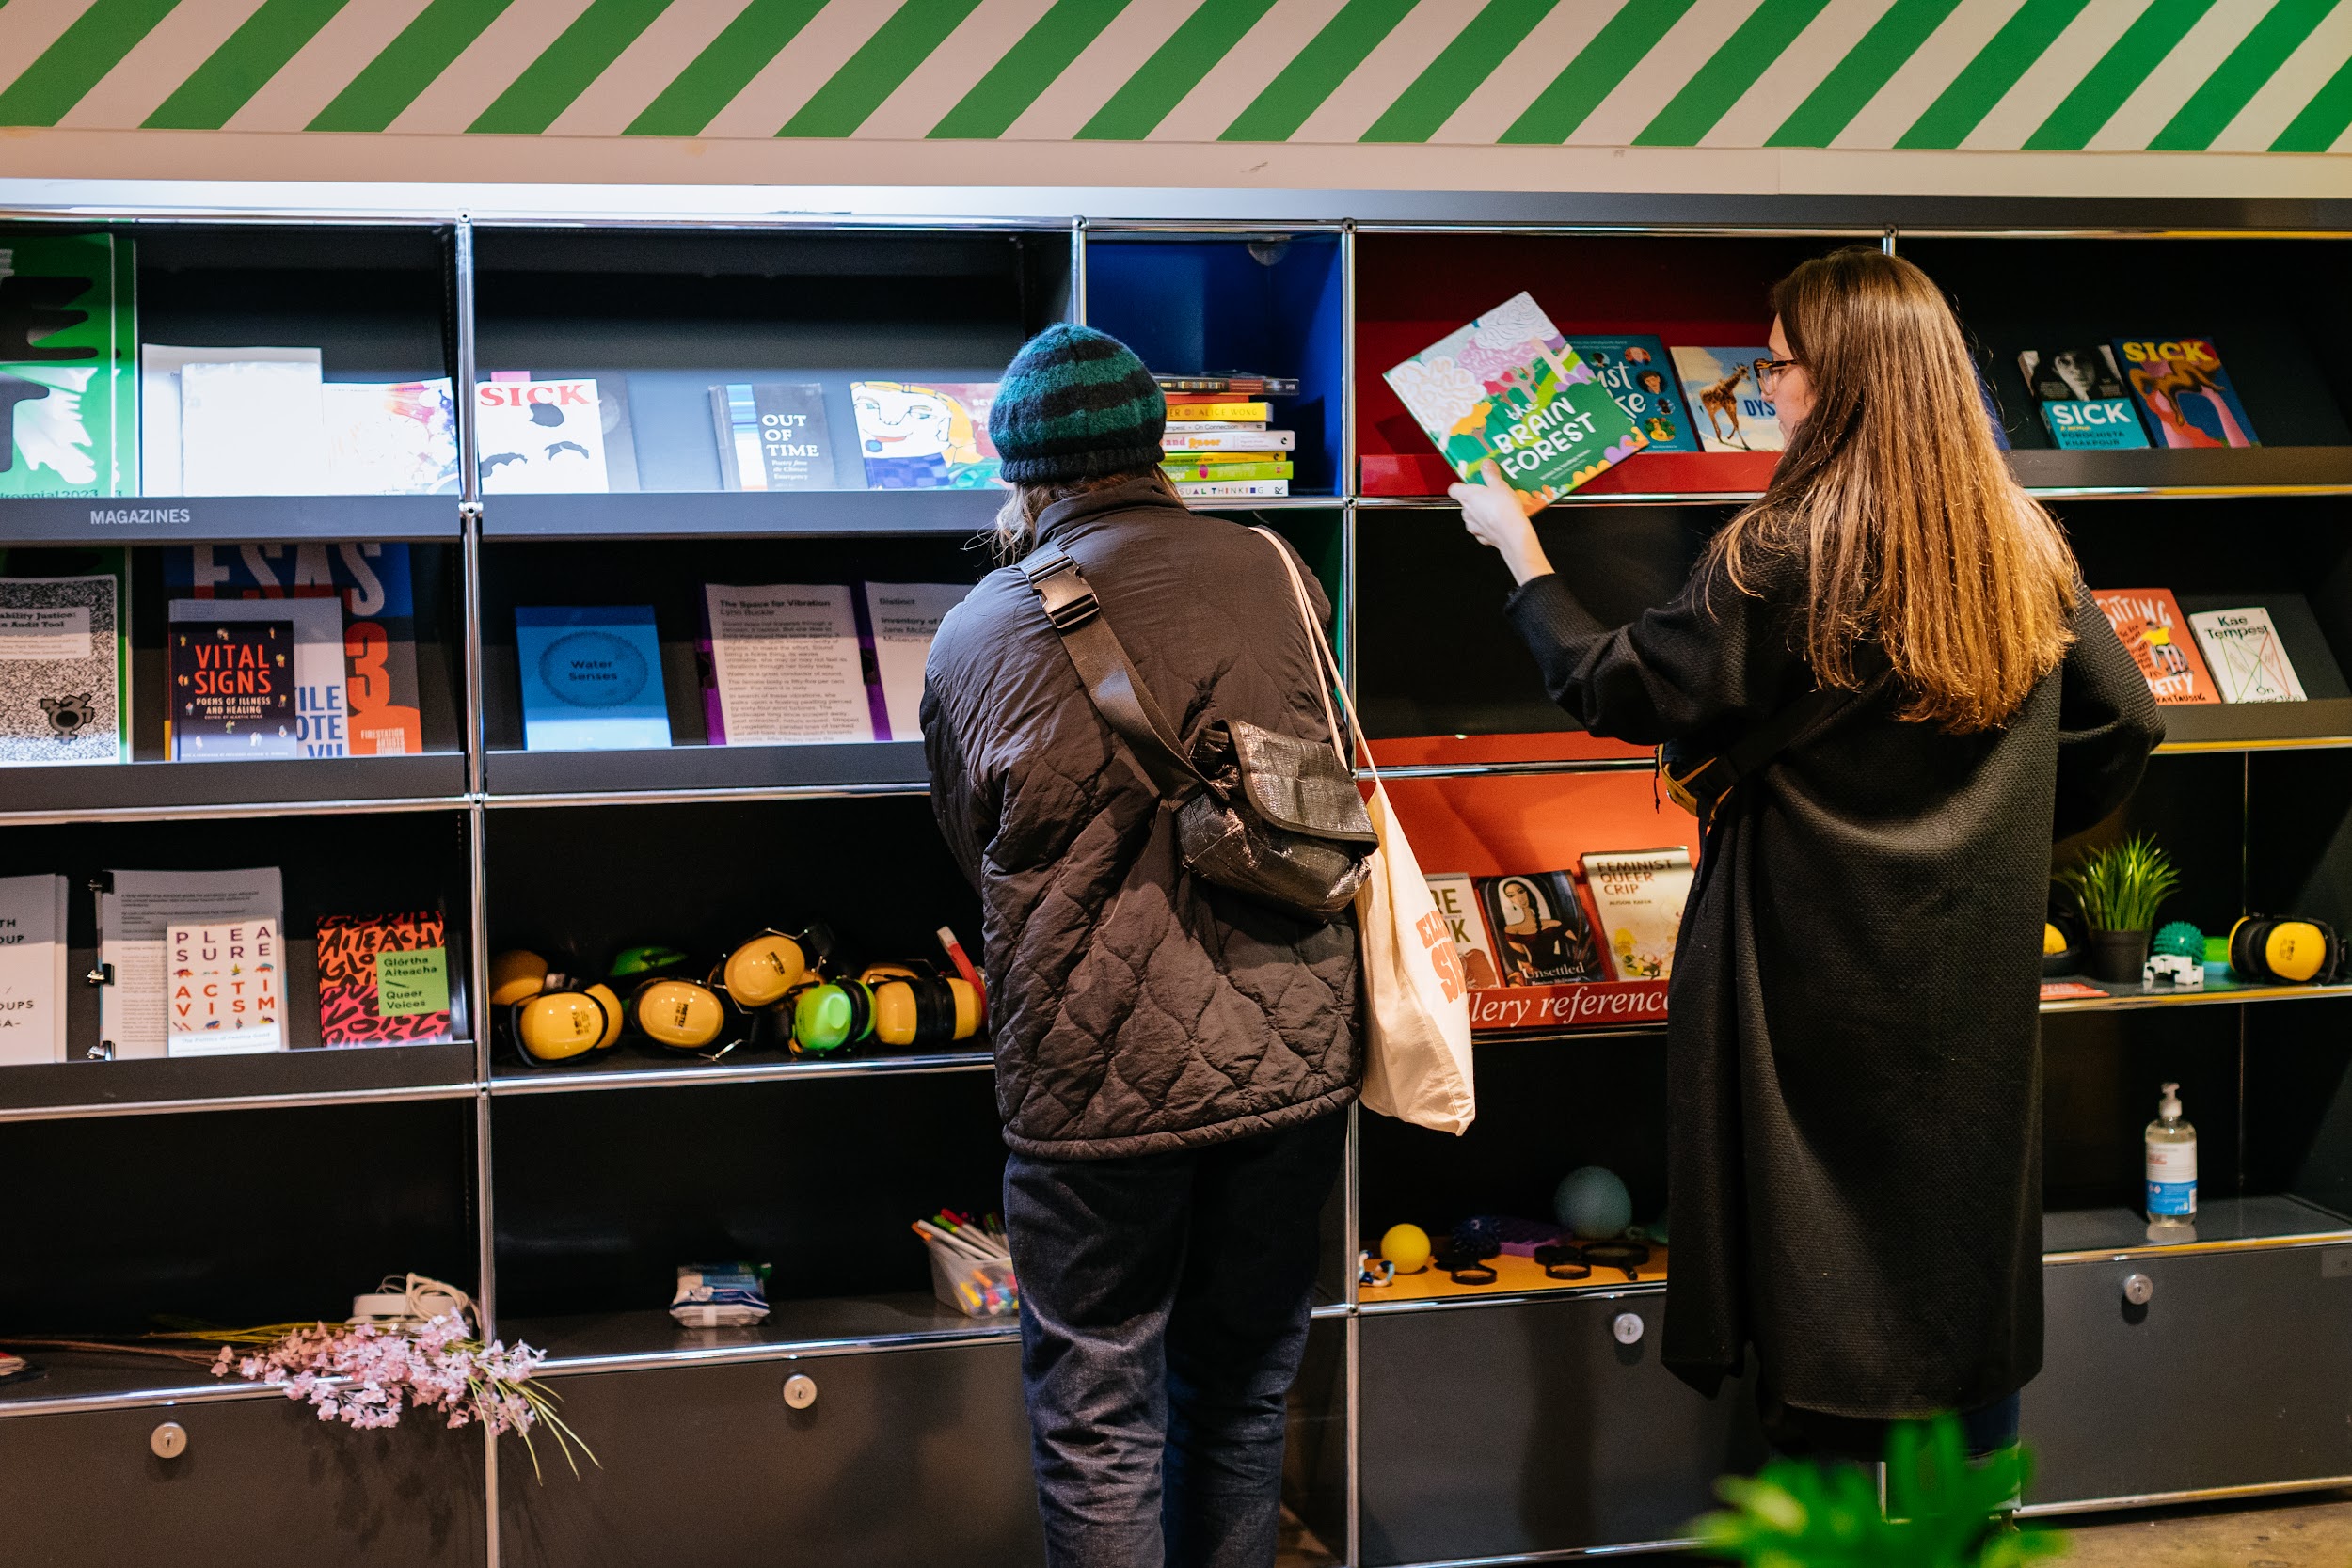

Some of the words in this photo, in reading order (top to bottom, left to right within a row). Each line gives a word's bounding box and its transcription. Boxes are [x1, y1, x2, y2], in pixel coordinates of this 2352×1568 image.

[2122, 341, 2213, 363] SICK
[480, 387, 590, 406] SICK
[1505, 402, 1538, 420] the
[1744, 400, 1776, 416] DYS
[2052, 403, 2131, 425] SICK
[762, 414, 807, 427] OUT
[1492, 397, 1576, 454] BRAIN
[764, 429, 792, 442] OF
[766, 444, 819, 457] TIME
[1500, 412, 1596, 480] FOREST
[91, 509, 190, 524] MAGAZINES
[2218, 616, 2248, 627] Kae
[2204, 624, 2269, 640] Tempest
[195, 644, 270, 668] VITAL
[194, 670, 271, 695] SIGNS
[569, 672, 617, 681] Senses
[2256, 686, 2274, 695] On
[295, 686, 342, 711] ILE
[1597, 860, 1672, 872] FEMINIST
[1600, 872, 1654, 884] QUEER
[1604, 884, 1639, 895] CRIP
[383, 957, 428, 967] Glórtha
[385, 966, 437, 977] Aiteacha
[1522, 962, 1585, 978] Unsettled
[386, 990, 423, 1000] Queer
[387, 999, 426, 1010] Voices
